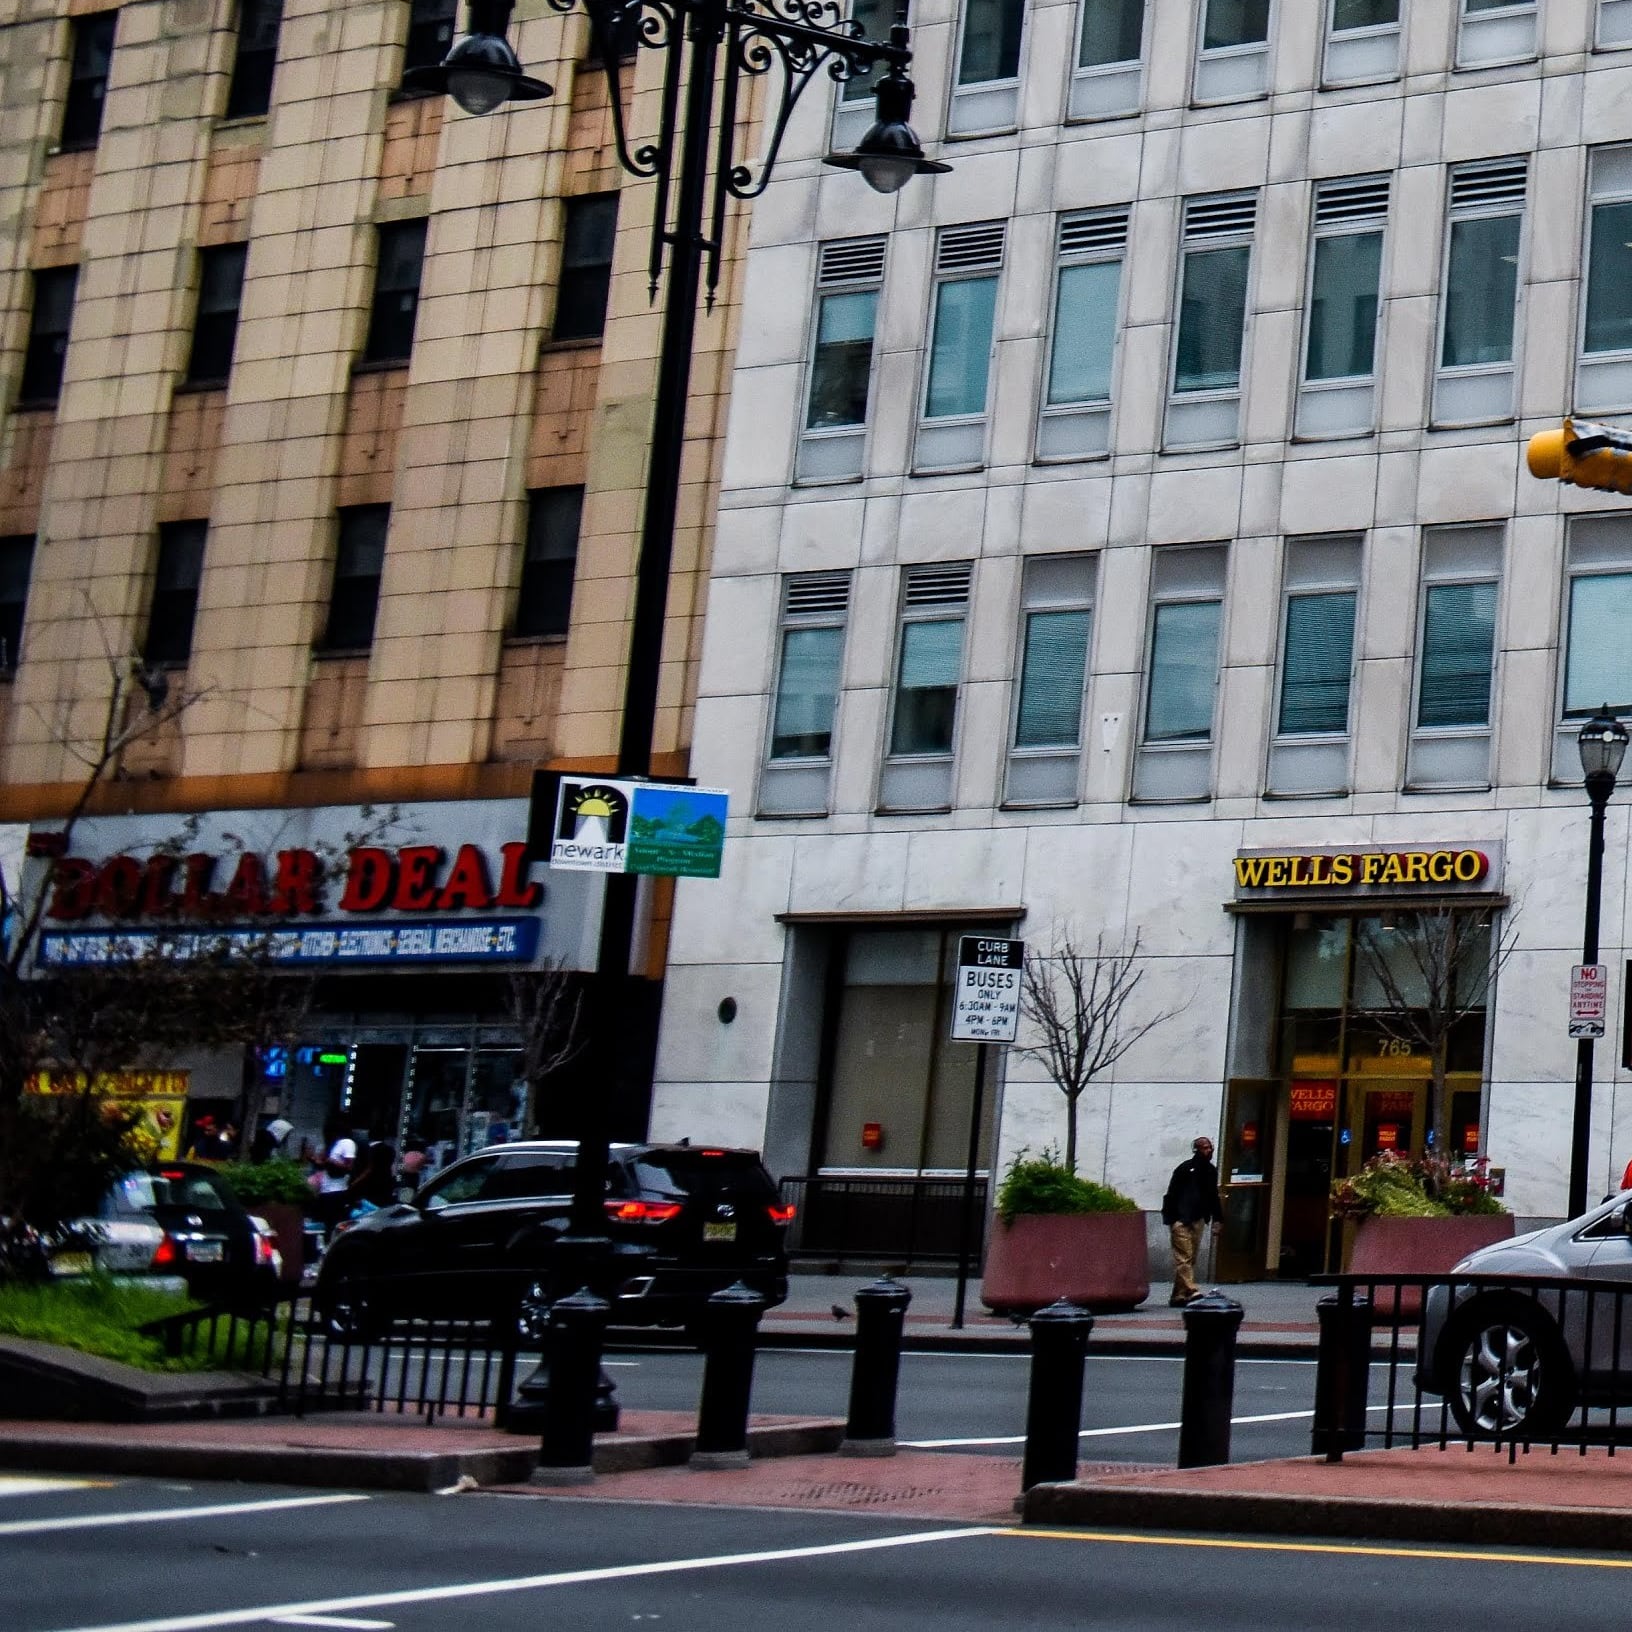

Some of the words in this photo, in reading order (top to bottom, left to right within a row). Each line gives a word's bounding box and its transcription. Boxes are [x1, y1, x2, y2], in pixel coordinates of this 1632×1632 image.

[552, 842, 624, 861] newark
[1234, 856, 1353, 886] WELLS
[1360, 850, 1482, 884] FARGO
[48, 848, 318, 920] DOLLAR
[339, 841, 542, 911] DEAL
[977, 941, 1008, 953] CURB
[977, 953, 1008, 966] LANE
[966, 971, 1013, 989] BUSES
[1581, 968, 1597, 980] NO
[977, 989, 1000, 1000] ONLY
[1000, 1002, 1015, 1013] 9AM
[965, 1014, 984, 1025] 4PM
[991, 1015, 1008, 1026] 6PM
[1378, 1039, 1412, 1057] 765
[1292, 1100, 1334, 1111] ARGO
